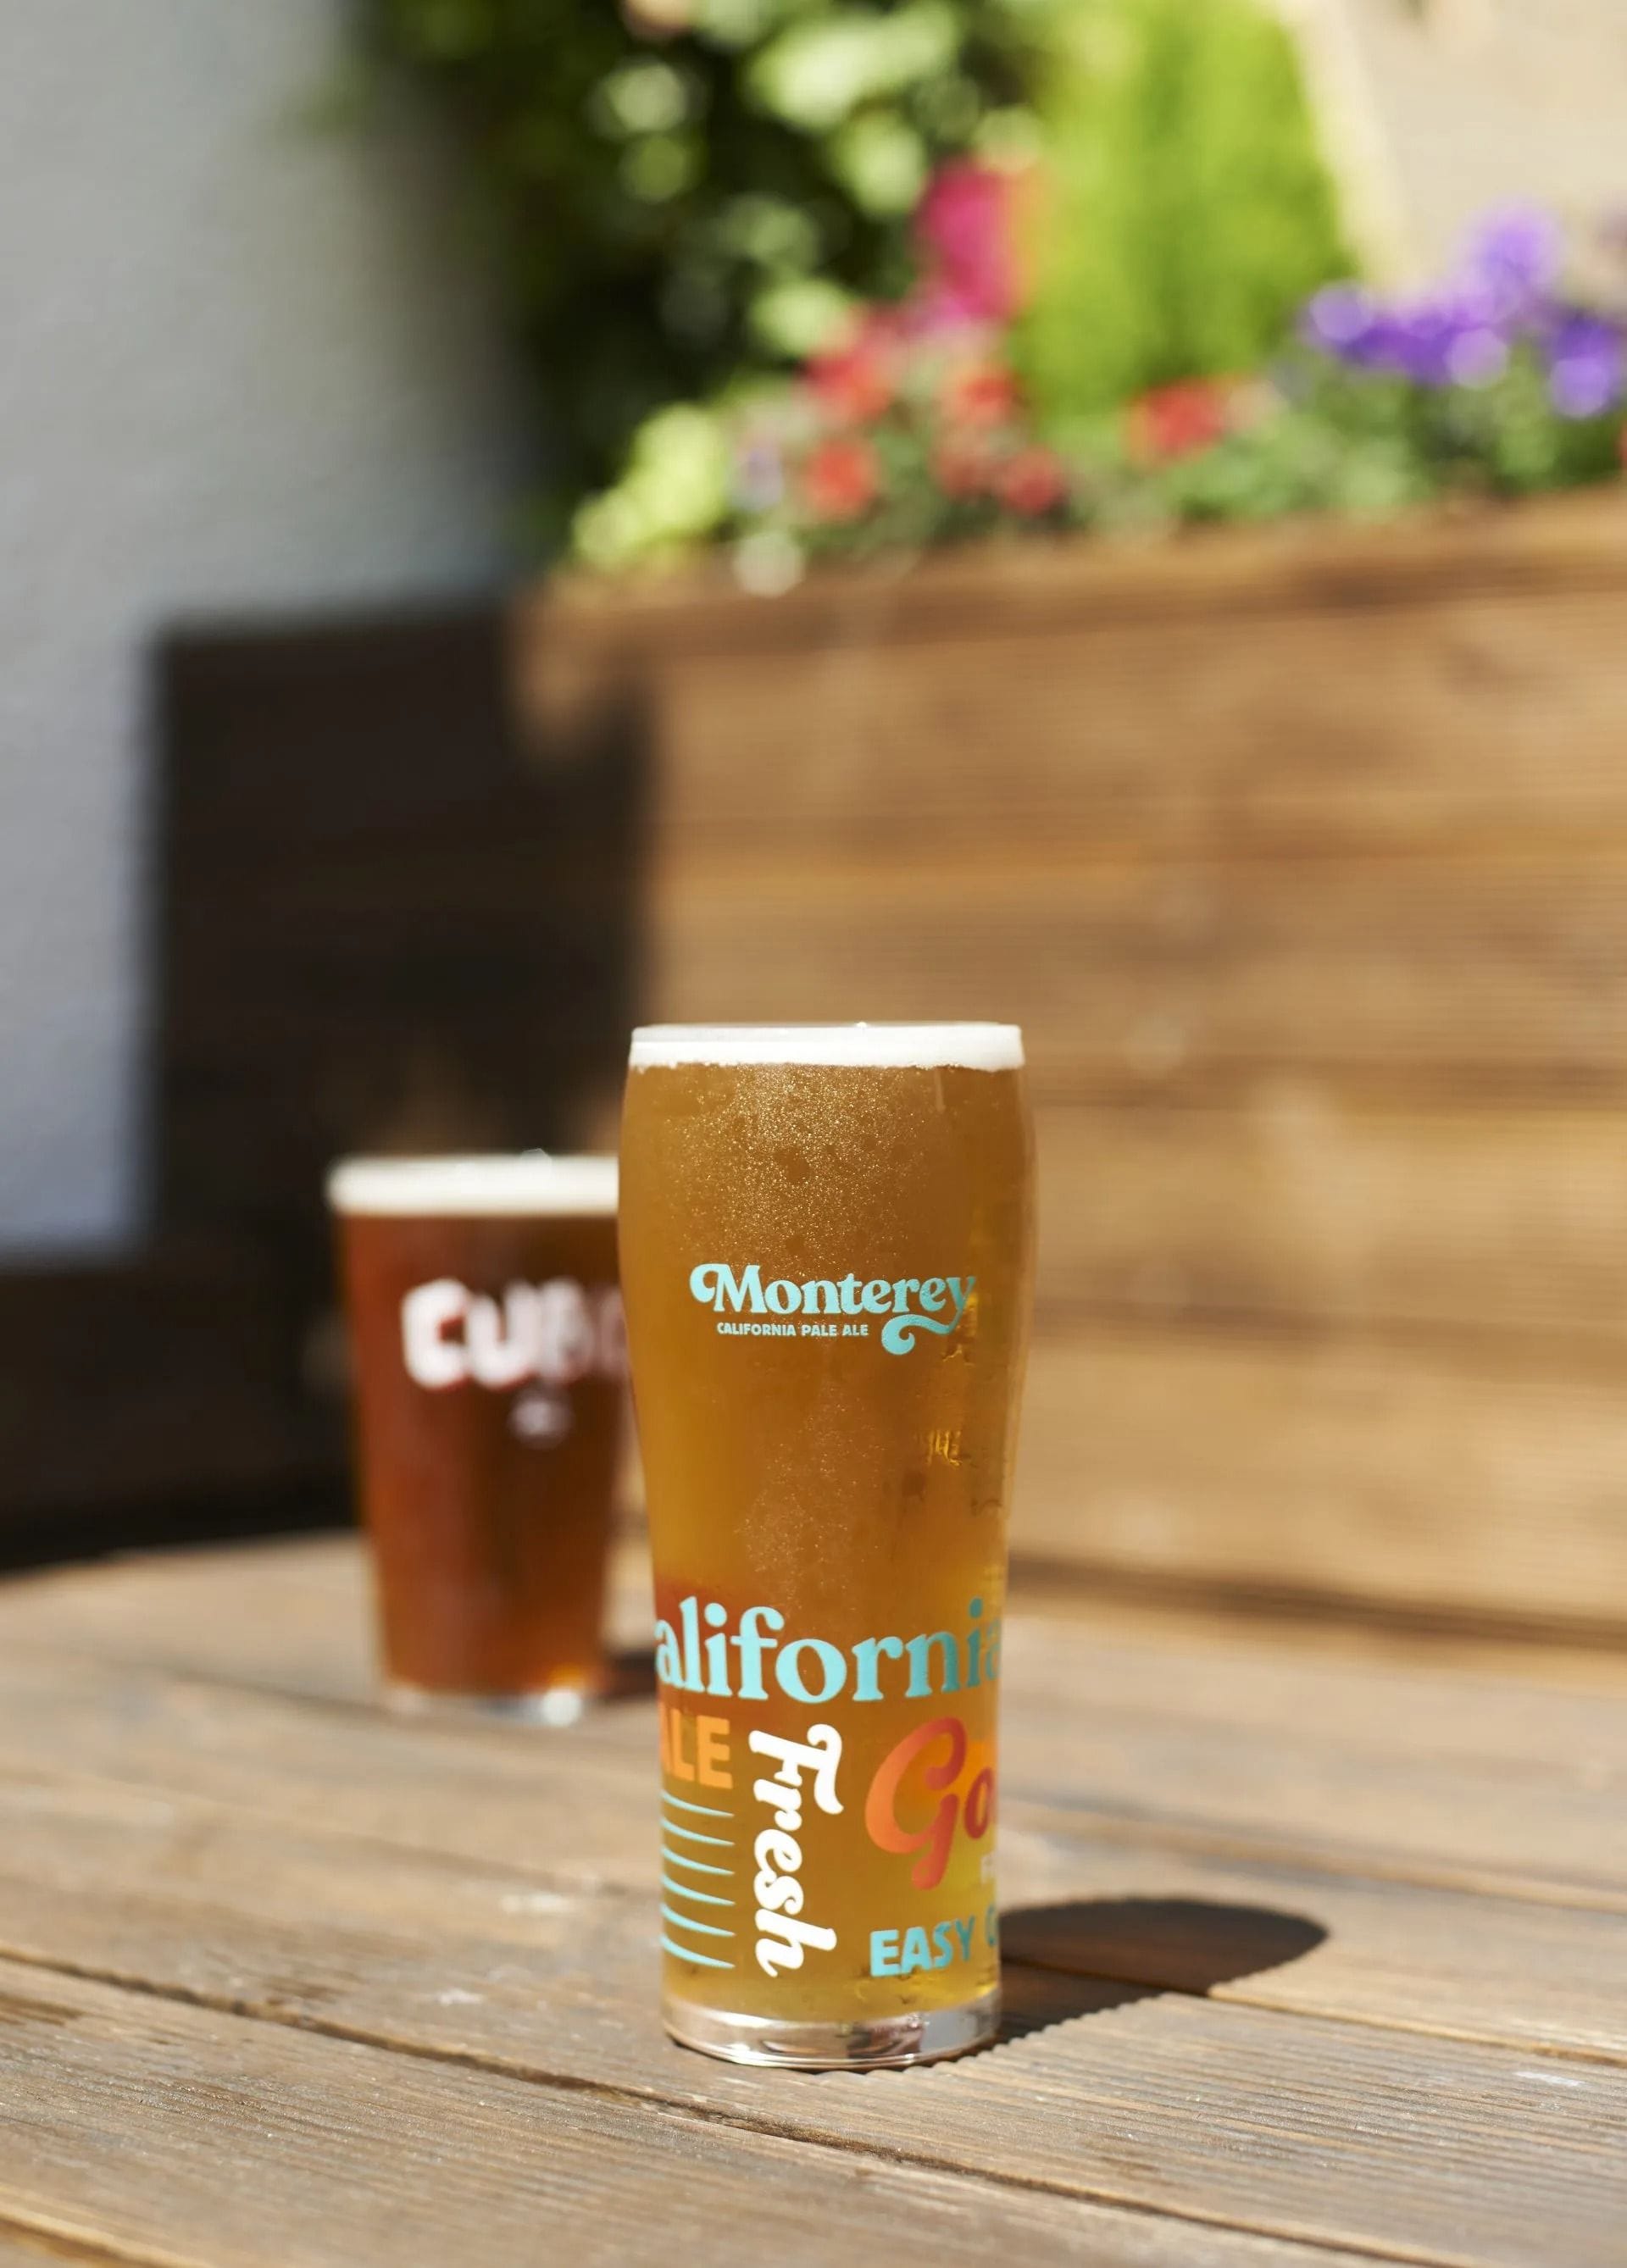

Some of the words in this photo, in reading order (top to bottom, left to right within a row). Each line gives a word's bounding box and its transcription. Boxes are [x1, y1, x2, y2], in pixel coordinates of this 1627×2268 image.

[689, 1263, 976, 1355] Monterey
[717, 1323, 797, 1336] CALIFORNIA
[801, 1324, 838, 1336] PALE
[842, 1324, 869, 1336] ALE
[749, 1723, 844, 1977] Fresh
[869, 1916, 975, 1977] EASY
